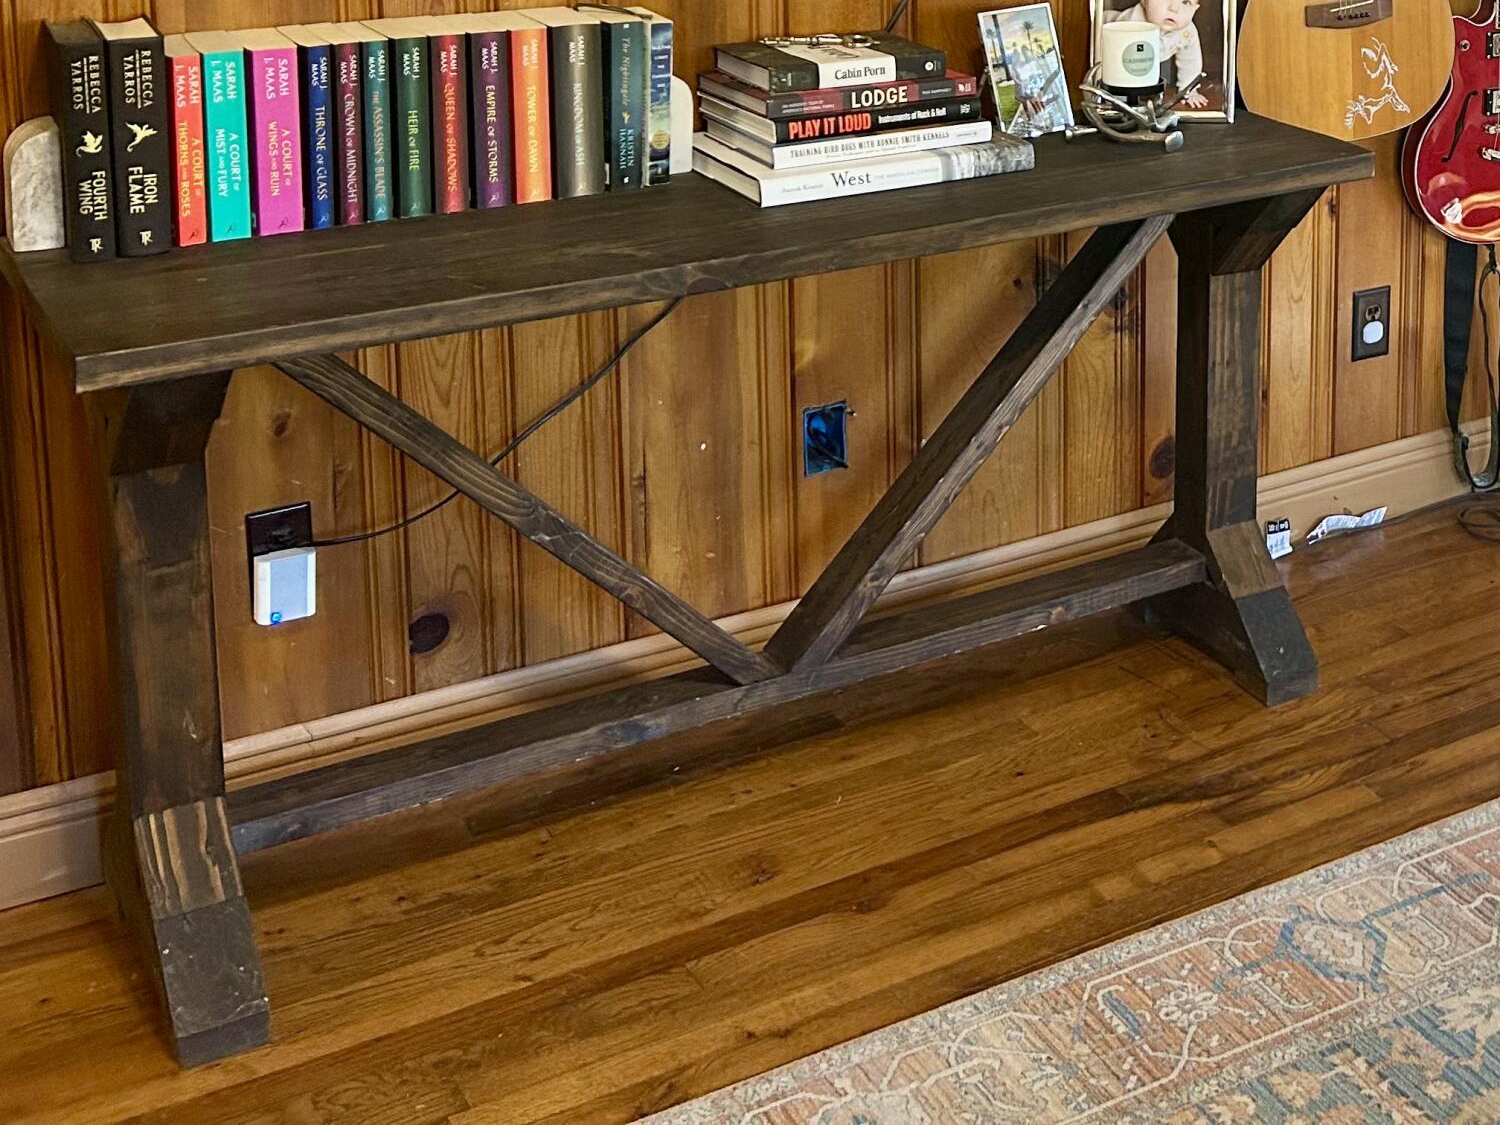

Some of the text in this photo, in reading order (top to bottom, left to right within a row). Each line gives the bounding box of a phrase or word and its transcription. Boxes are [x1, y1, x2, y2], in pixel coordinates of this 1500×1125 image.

[349, 55, 357, 82] SARAH
[368, 56, 376, 79] MAAS
[377, 49, 385, 75] SARAH
[403, 53, 411, 76] MAAS
[412, 47, 420, 74] SARAH
[449, 44, 457, 72] SARAH
[481, 47, 490, 70] MAAS
[490, 41, 498, 68] SARAH
[70, 61, 84, 110] YARROS
[88, 55, 101, 113] REBECCA
[123, 55, 136, 104] YARROS
[141, 50, 153, 107] REBECCA
[188, 66, 200, 104] SARAH
[212, 70, 224, 103] MAAS
[225, 61, 237, 99] SARAH
[265, 67, 276, 100] MAAS
[278, 58, 290, 96] SARAH
[311, 63, 319, 87] MAAS
[340, 61, 348, 84] MAAS
[619, 37, 631, 107] The Nightingale
[834, 66, 886, 80] Cabin Porn
[176, 75, 186, 108] MAAS
[444, 82, 456, 120] QUEEN
[485, 84, 497, 123] EMPIRE
[526, 84, 537, 123] TOWER
[572, 82, 585, 133] KINGDOM
[851, 85, 908, 109] LODGE
[315, 105, 326, 152] THRONE
[344, 93, 356, 136] CROWN
[408, 110, 418, 135] HEIR
[789, 113, 871, 140] PLAY IT LOUD
[931, 108, 936, 117] &
[178, 122, 189, 166] THORNS
[191, 138, 201, 146] A
[215, 128, 226, 154] MIST
[229, 133, 239, 141] A
[268, 121, 278, 156] WINGS
[281, 129, 291, 137] A
[619, 129, 627, 169] HANNAH
[627, 129, 635, 167] KRISTIN
[790, 147, 822, 158] TRAINING
[824, 144, 839, 154] BIRD
[841, 142, 856, 152] DOGS
[858, 140, 875, 149] WITH
[901, 135, 921, 144] SMITH
[192, 149, 203, 187] COURT
[229, 144, 241, 181] COURT
[282, 140, 293, 177] COURT
[409, 150, 420, 172] FIRE
[446, 137, 458, 193] SHADOWS
[487, 139, 498, 183] STORMS
[528, 139, 538, 172] DAWN
[575, 145, 585, 166] ASH
[128, 166, 145, 214] FLAME
[143, 174, 159, 203] IRON
[218, 169, 228, 197] FURY
[271, 171, 280, 196] RUIN
[316, 167, 328, 201] GLASS
[346, 149, 357, 203] MIDNIGHT
[375, 166, 386, 198] BLADE
[830, 171, 871, 187] West
[78, 180, 93, 214] WING
[92, 171, 108, 221] FOURTH
[180, 180, 191, 217] ROSES
